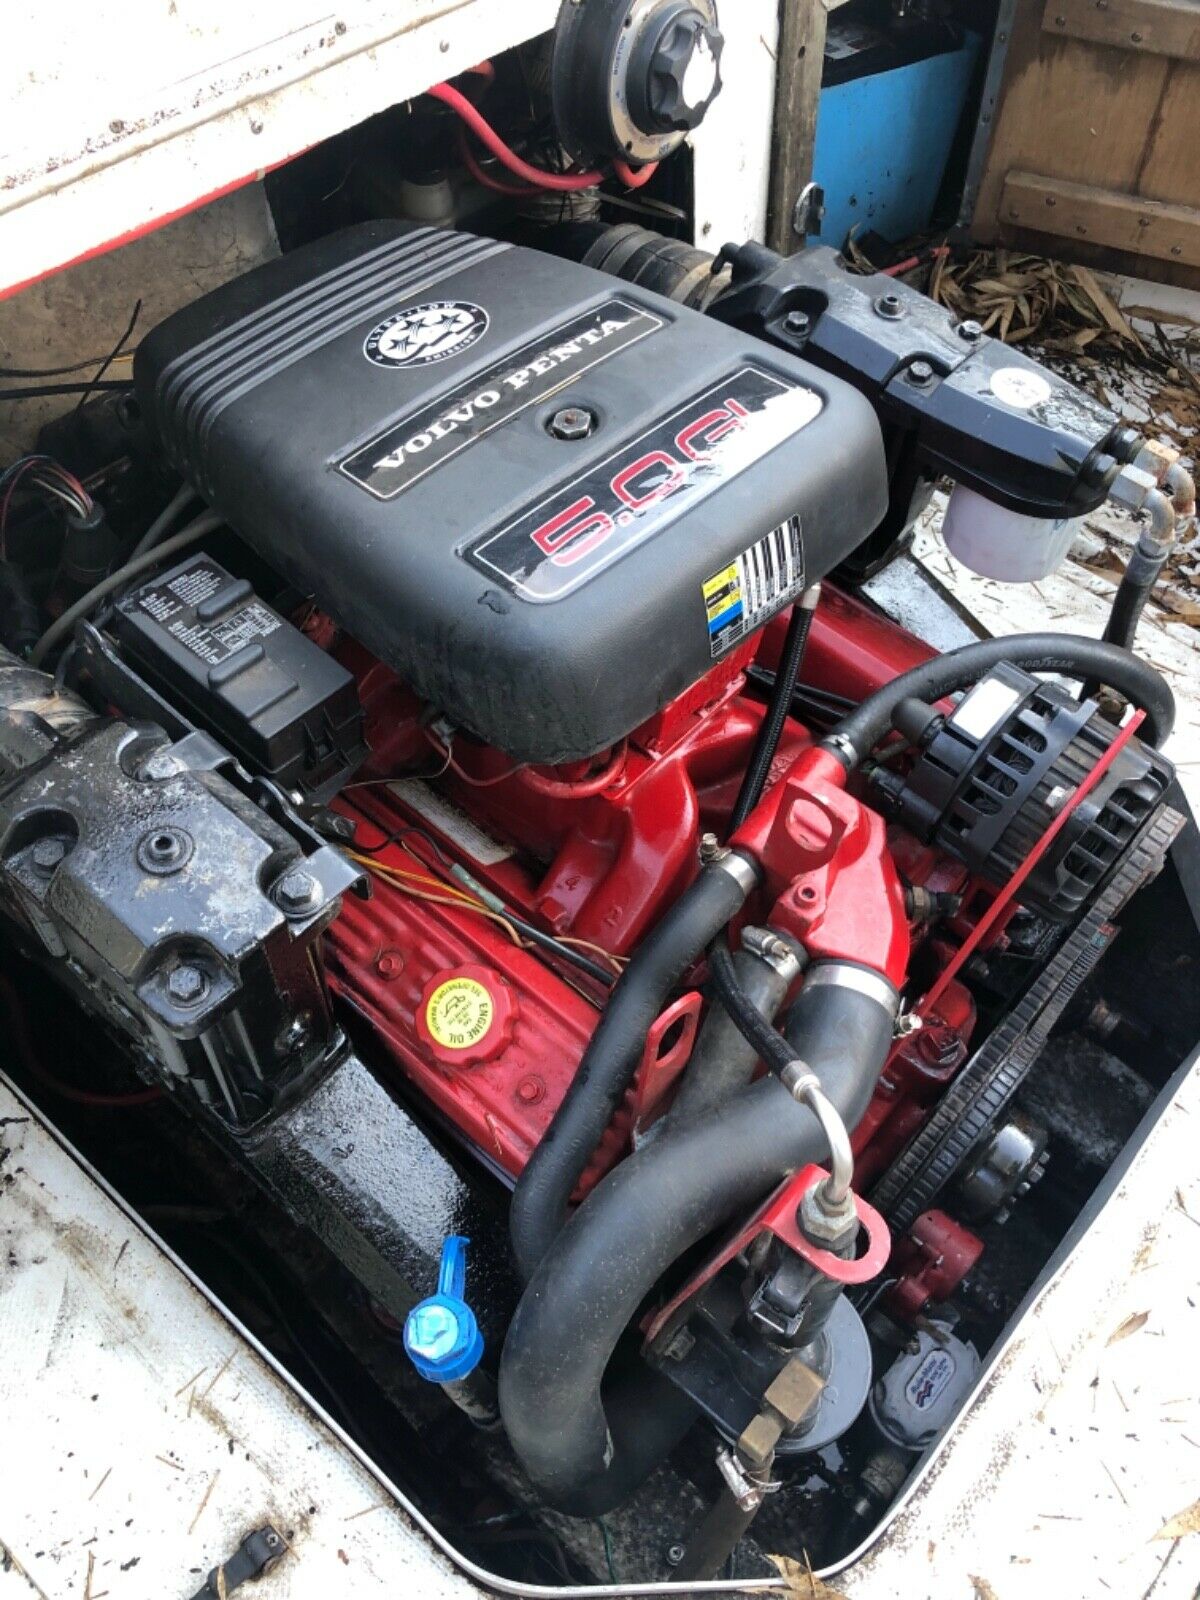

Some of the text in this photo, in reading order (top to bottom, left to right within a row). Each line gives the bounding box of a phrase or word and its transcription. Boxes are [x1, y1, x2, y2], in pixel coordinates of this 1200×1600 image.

[373, 319, 630, 470] VOLVO PENTA
[1013, 656, 1076, 669] OODYEAR
[466, 1002, 489, 1040] ENGINE
[448, 1032, 465, 1044] OIL
